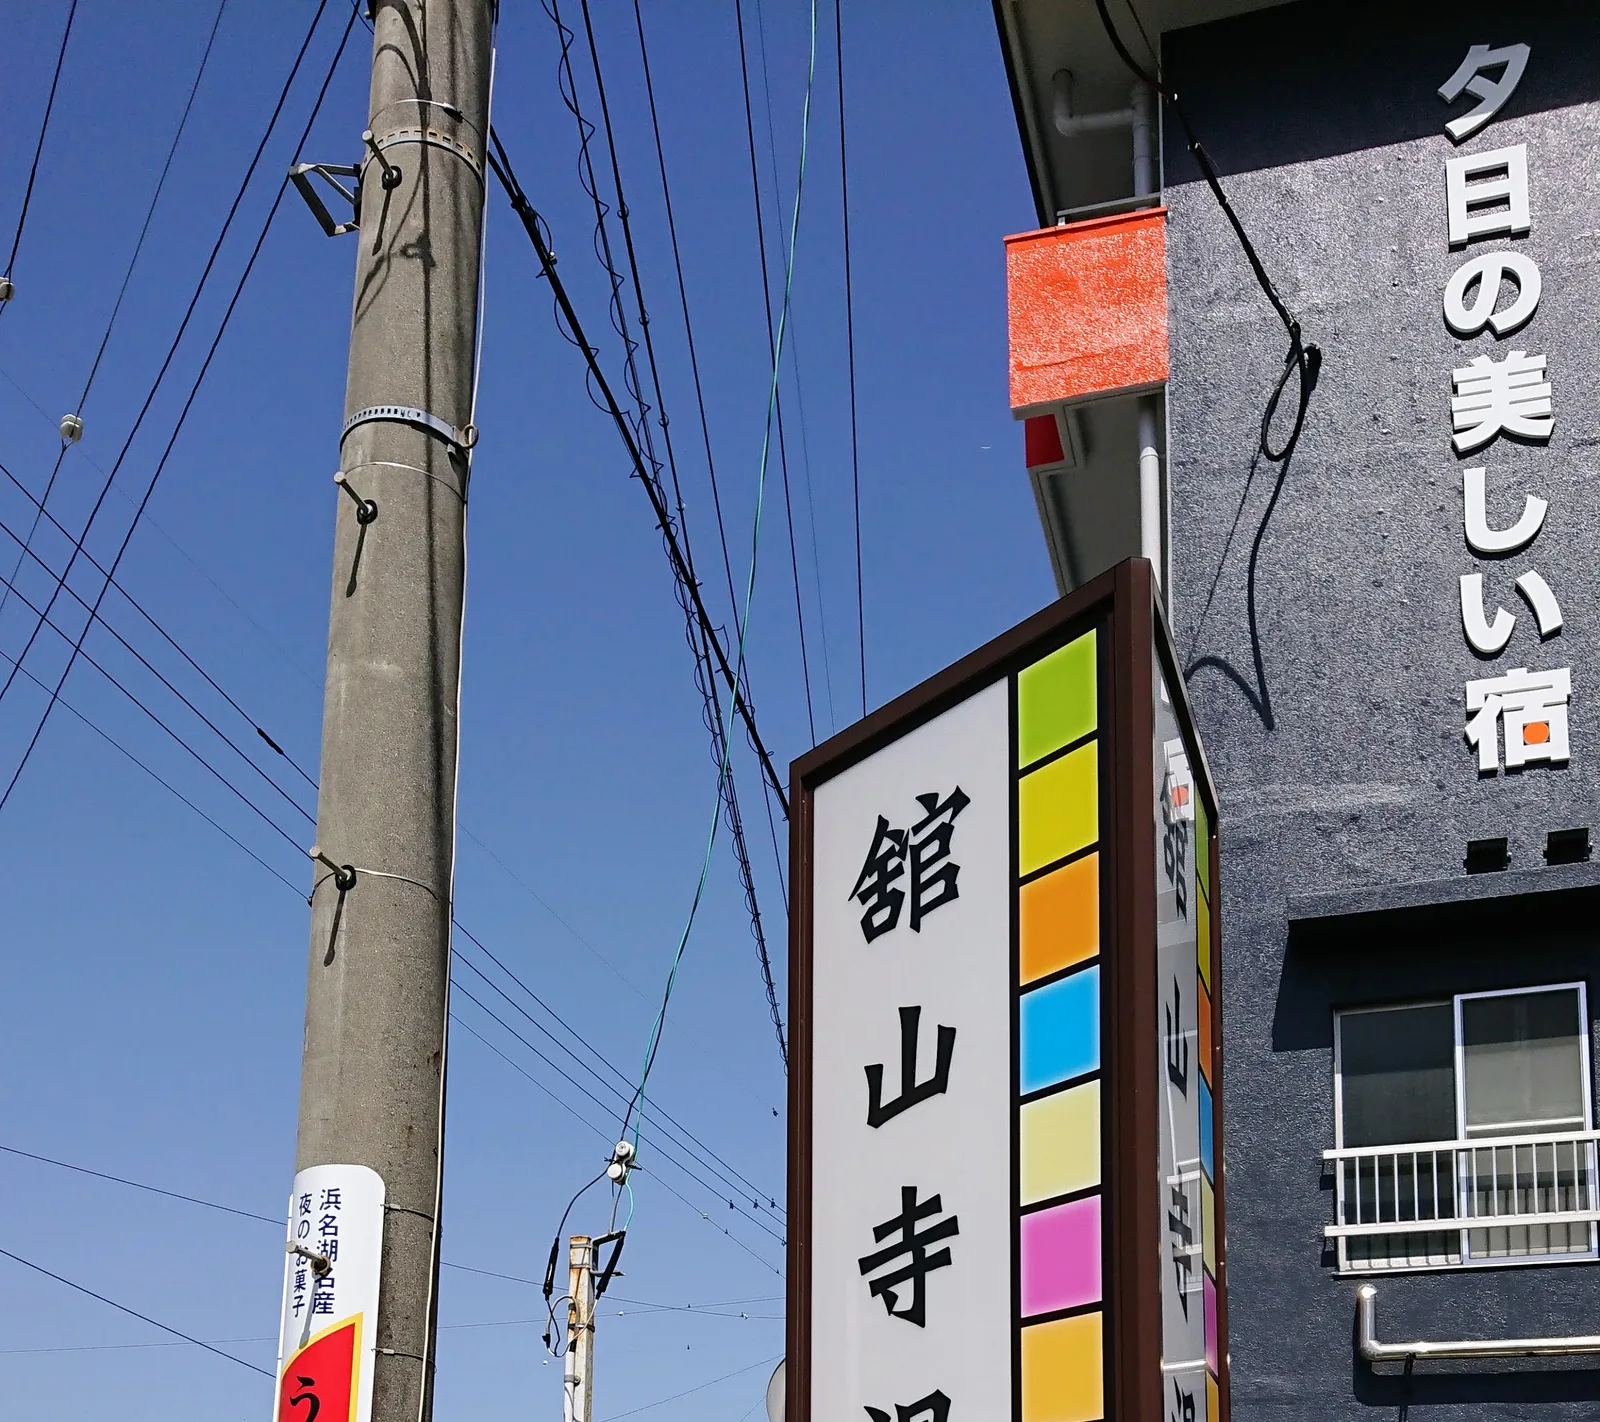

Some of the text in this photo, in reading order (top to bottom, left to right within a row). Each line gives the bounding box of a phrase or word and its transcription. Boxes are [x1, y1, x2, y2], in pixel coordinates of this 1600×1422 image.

[1437, 42, 1571, 773] 夕日の美しい宿
[292, 1193, 313, 1318] 夜のお菓子
[312, 1188, 342, 1315] 浜名湖名産
